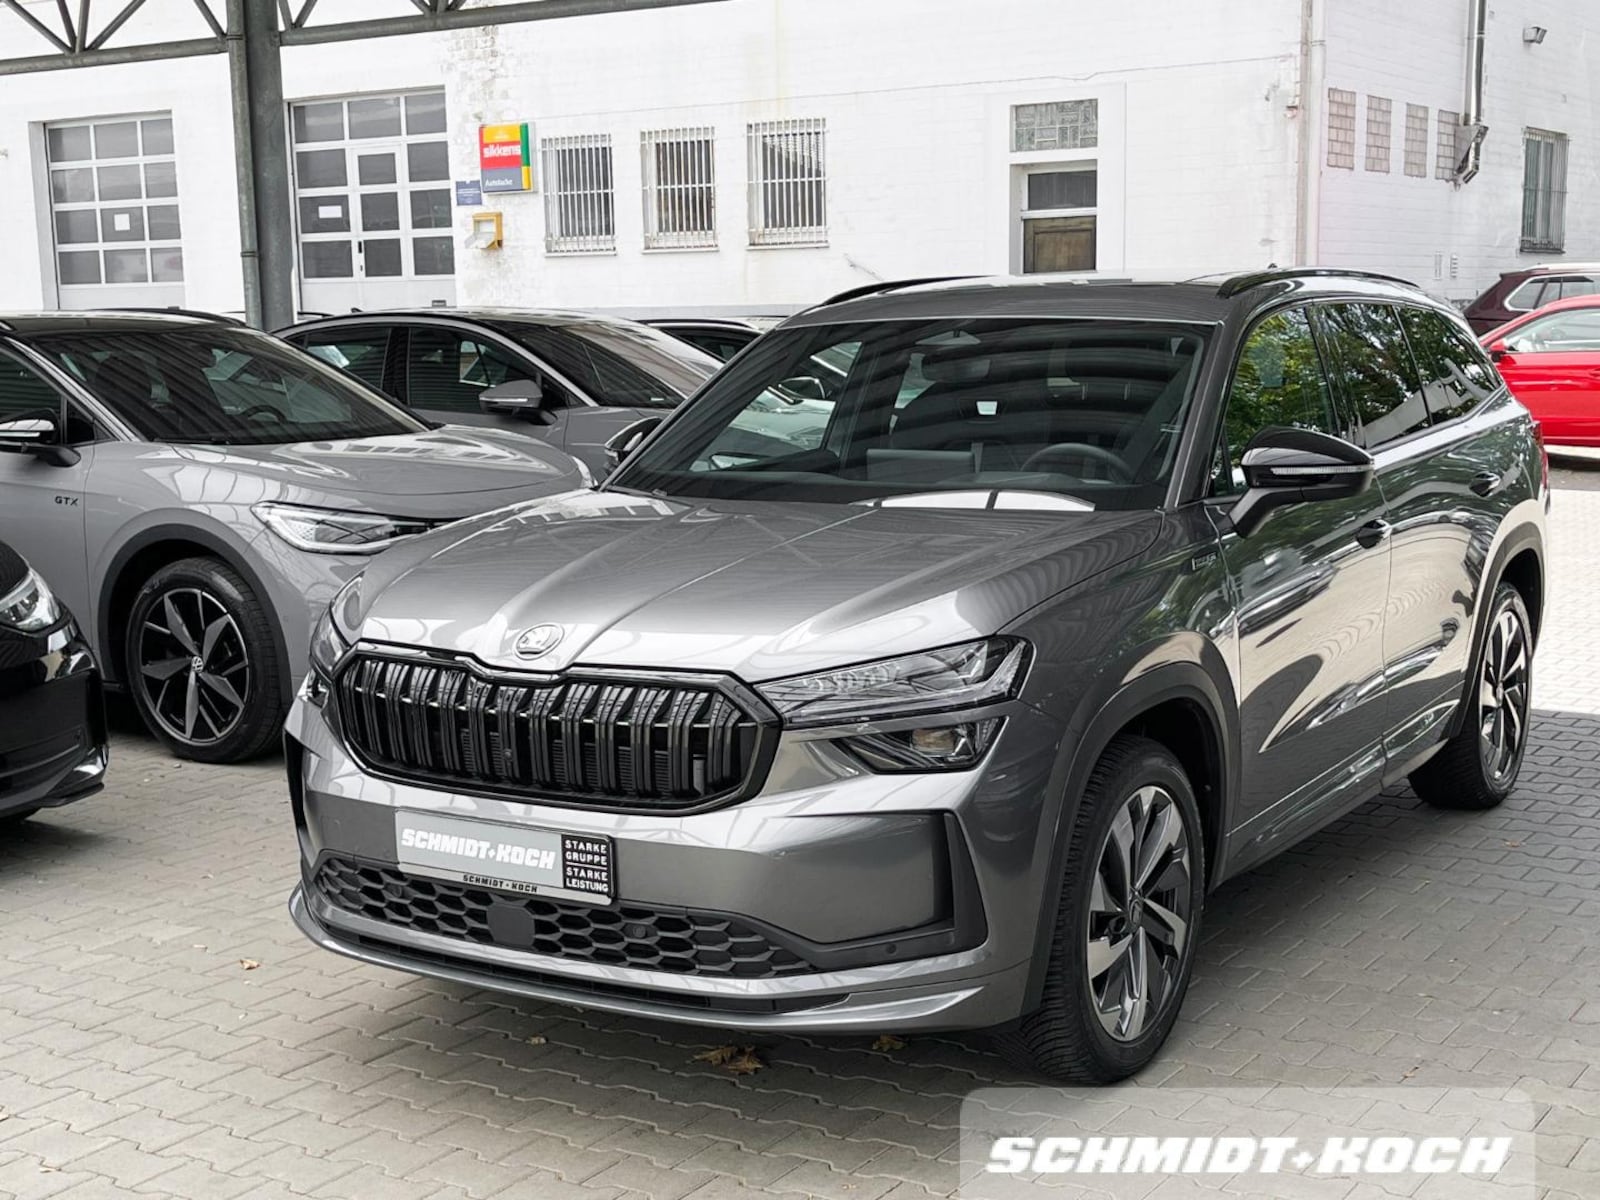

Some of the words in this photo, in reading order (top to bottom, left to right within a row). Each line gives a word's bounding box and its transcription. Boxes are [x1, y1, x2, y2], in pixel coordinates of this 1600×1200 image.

[55, 495, 78, 506] GTX
[565, 839, 607, 854] STARKE
[566, 851, 608, 866] GRUPPE
[566, 866, 608, 881] STARKE
[566, 878, 609, 892] LEISTUNG
